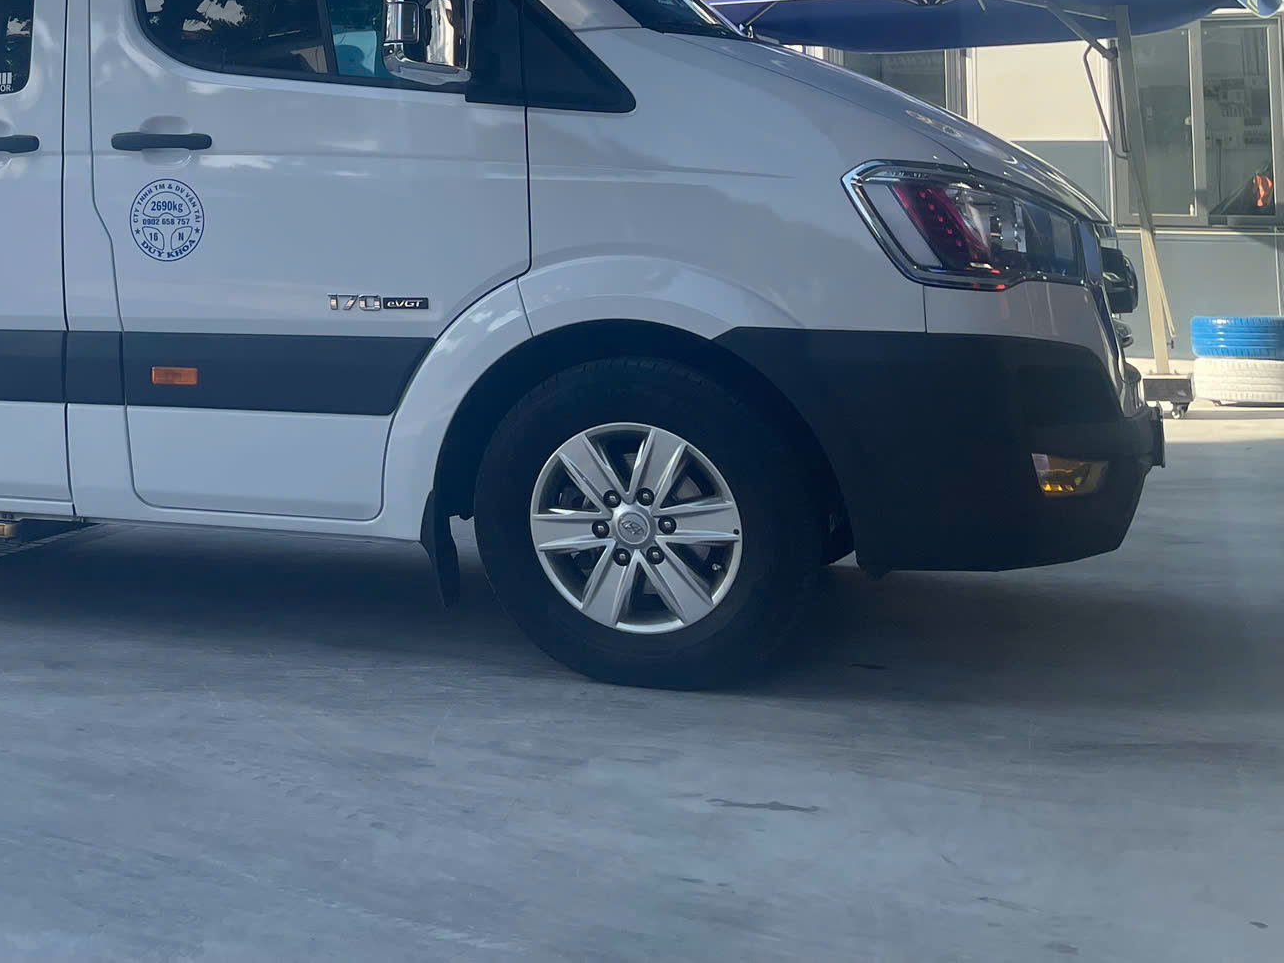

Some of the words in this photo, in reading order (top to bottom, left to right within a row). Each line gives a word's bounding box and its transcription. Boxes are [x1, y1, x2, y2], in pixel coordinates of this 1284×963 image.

[137, 188, 153, 206] TNHH
[175, 186, 185, 194] DV
[151, 201, 183, 213] 2690kg
[177, 218, 190, 226] 757
[149, 232, 158, 241] 16
[178, 232, 184, 241] N
[141, 241, 164, 257] DUY
[167, 239, 196, 258] KHOA
[327, 293, 382, 311] 170
[387, 299, 423, 308] eVGT
